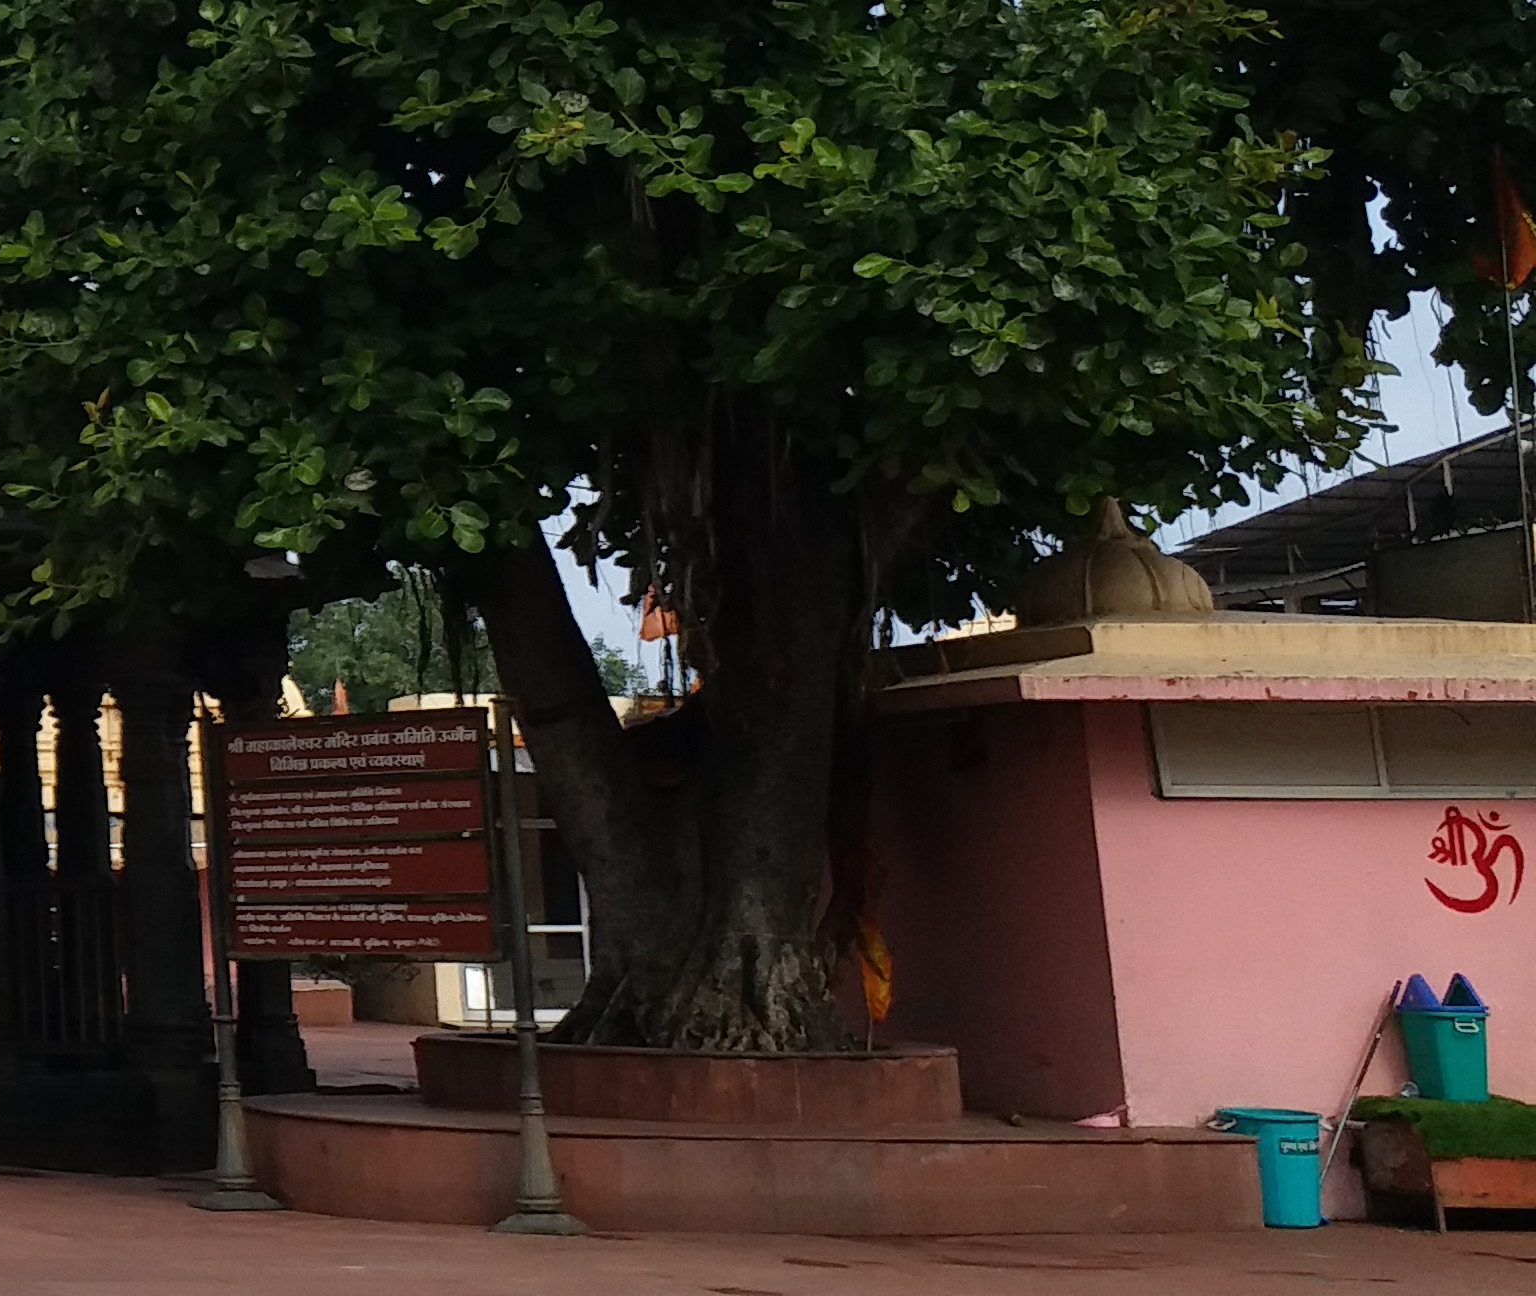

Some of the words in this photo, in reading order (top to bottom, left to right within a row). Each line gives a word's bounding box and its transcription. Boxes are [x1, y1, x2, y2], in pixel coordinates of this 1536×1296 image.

[227, 737, 243, 753] श्री
[245, 735, 322, 753] महाकालेश्वर
[324, 730, 359, 749] मंदिर
[392, 726, 436, 744] समिति
